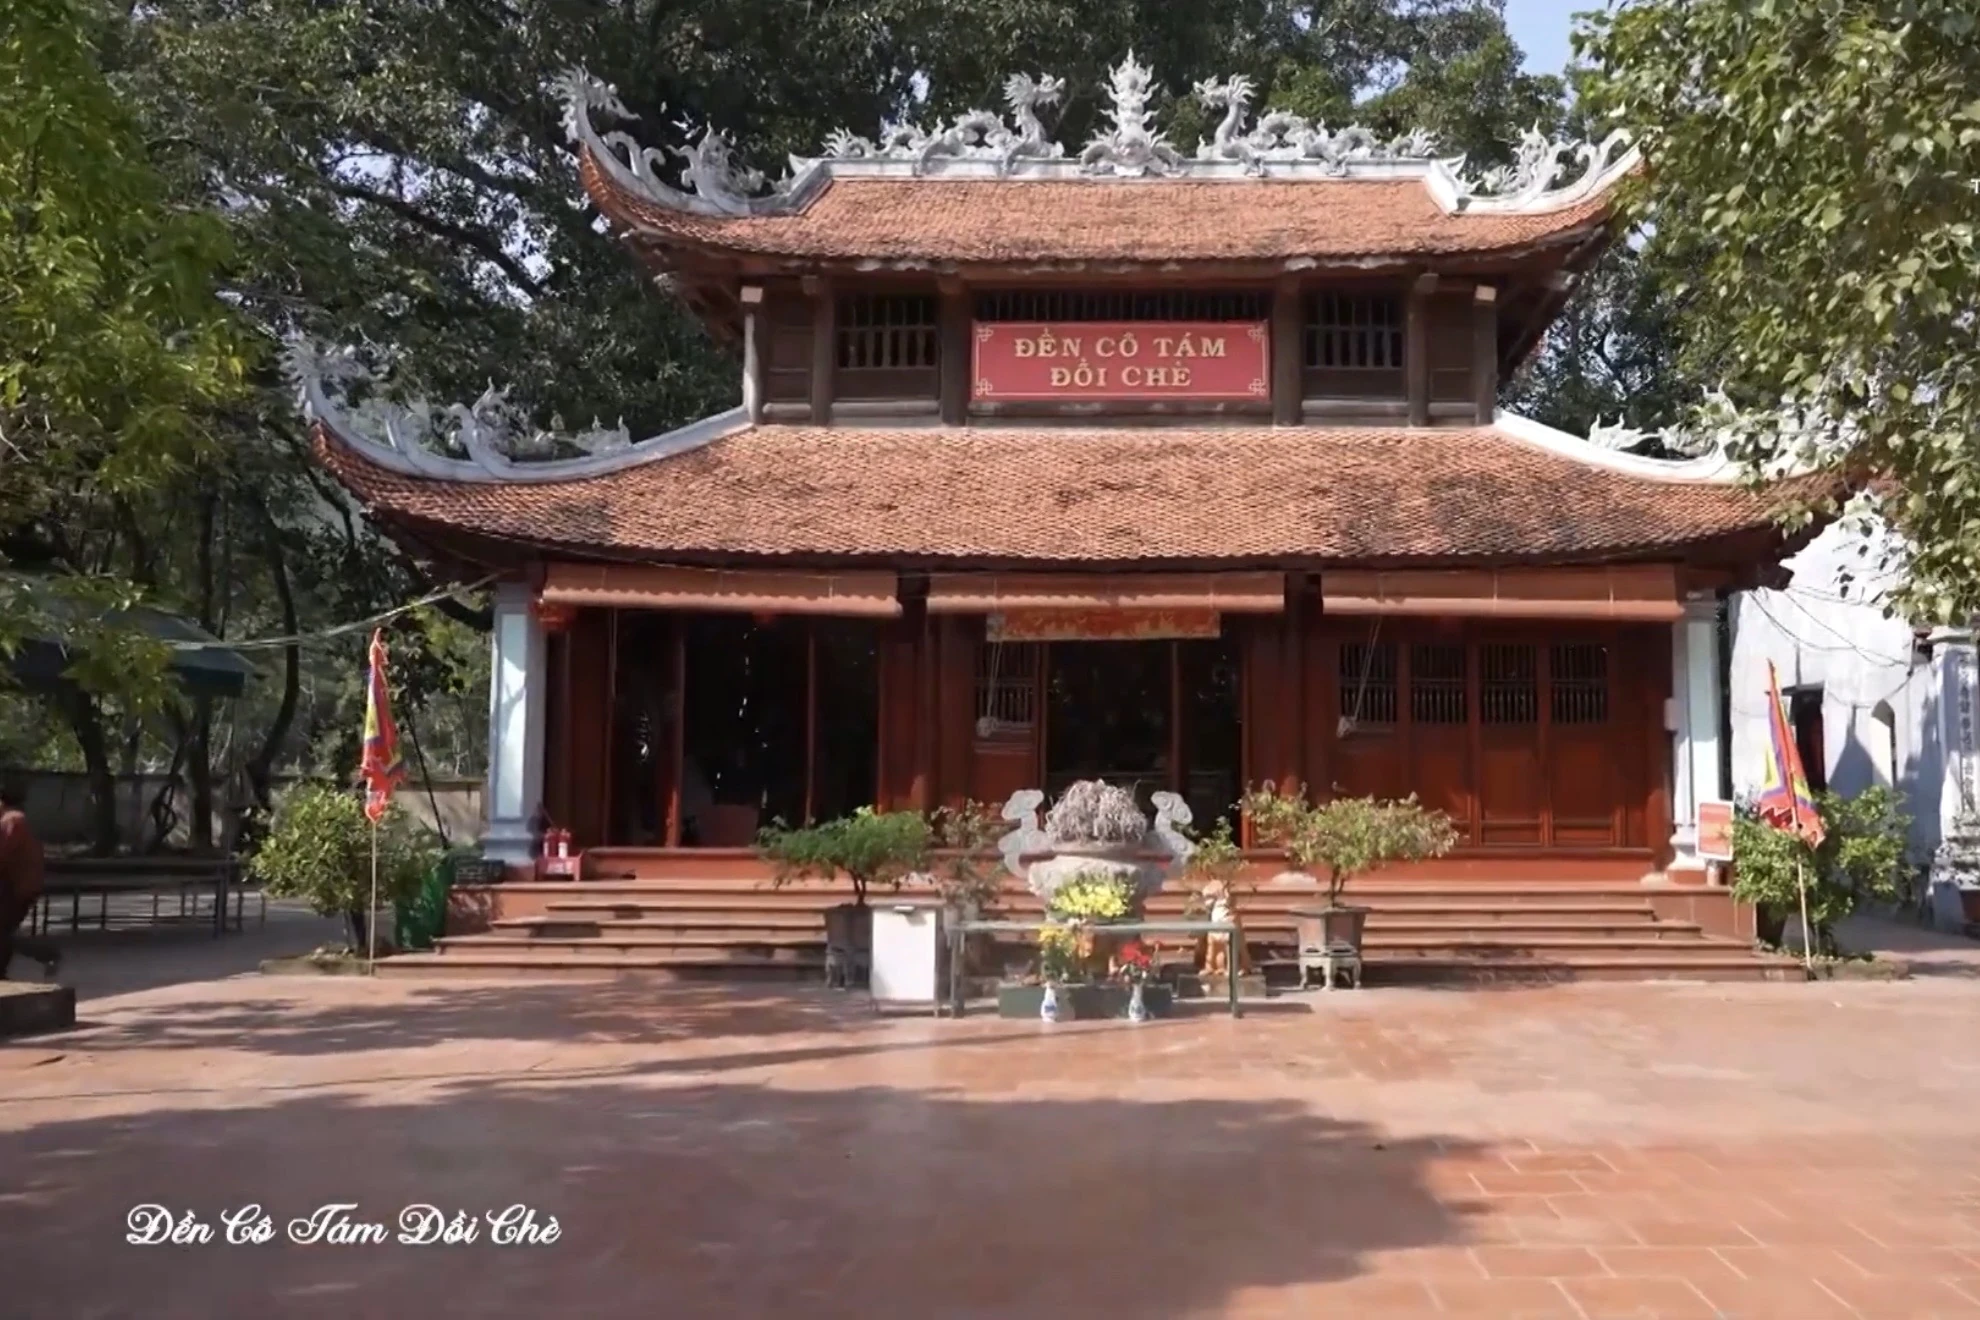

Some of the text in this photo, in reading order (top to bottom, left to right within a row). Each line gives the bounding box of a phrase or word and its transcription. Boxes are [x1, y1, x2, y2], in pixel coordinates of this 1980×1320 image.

[1014, 327, 1226, 358] ĐỀN CÔ TÁM
[1050, 358, 1108, 387] ĐỒI
